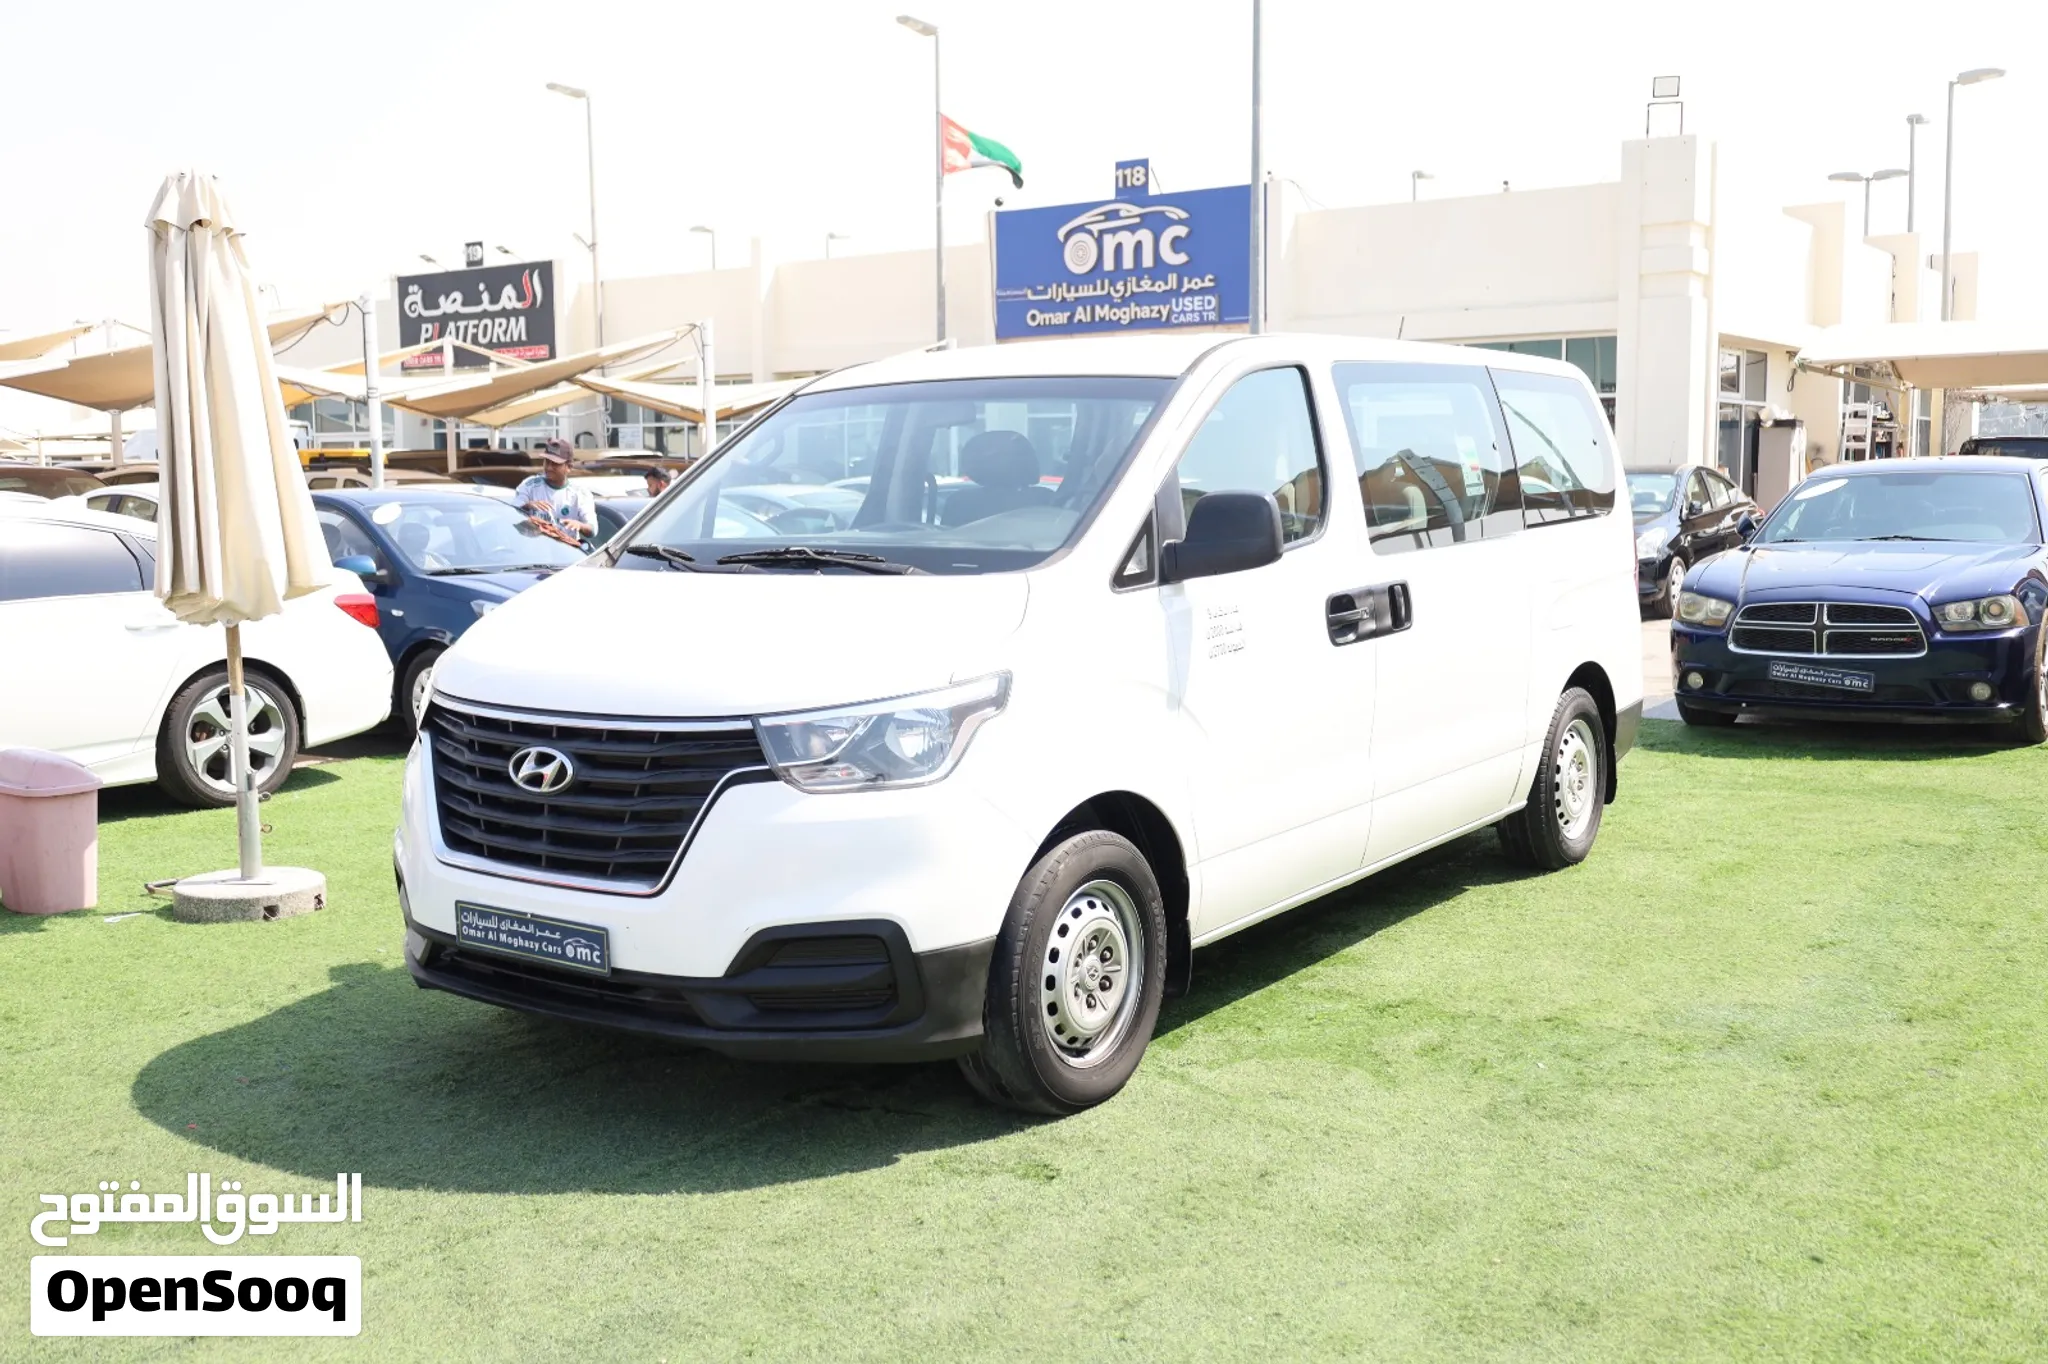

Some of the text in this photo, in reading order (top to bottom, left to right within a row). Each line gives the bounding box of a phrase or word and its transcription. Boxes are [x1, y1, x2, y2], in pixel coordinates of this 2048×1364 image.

[1116, 166, 1147, 188] 118
[404, 268, 544, 318] المنصة
[1026, 279, 1110, 304] للسيارات
[1110, 273, 1177, 302] المغازي
[1181, 273, 1216, 293] عمر
[1026, 302, 1171, 328] Omar Al Moghazy
[1171, 296, 1216, 312] USED
[1171, 311, 1216, 324] CARS TR
[420, 316, 528, 345] PLATFORM
[461, 911, 498, 929] للسيارات
[462, 925, 562, 955] Omar Al Moghazy Cars
[534, 927, 561, 940] عمر
